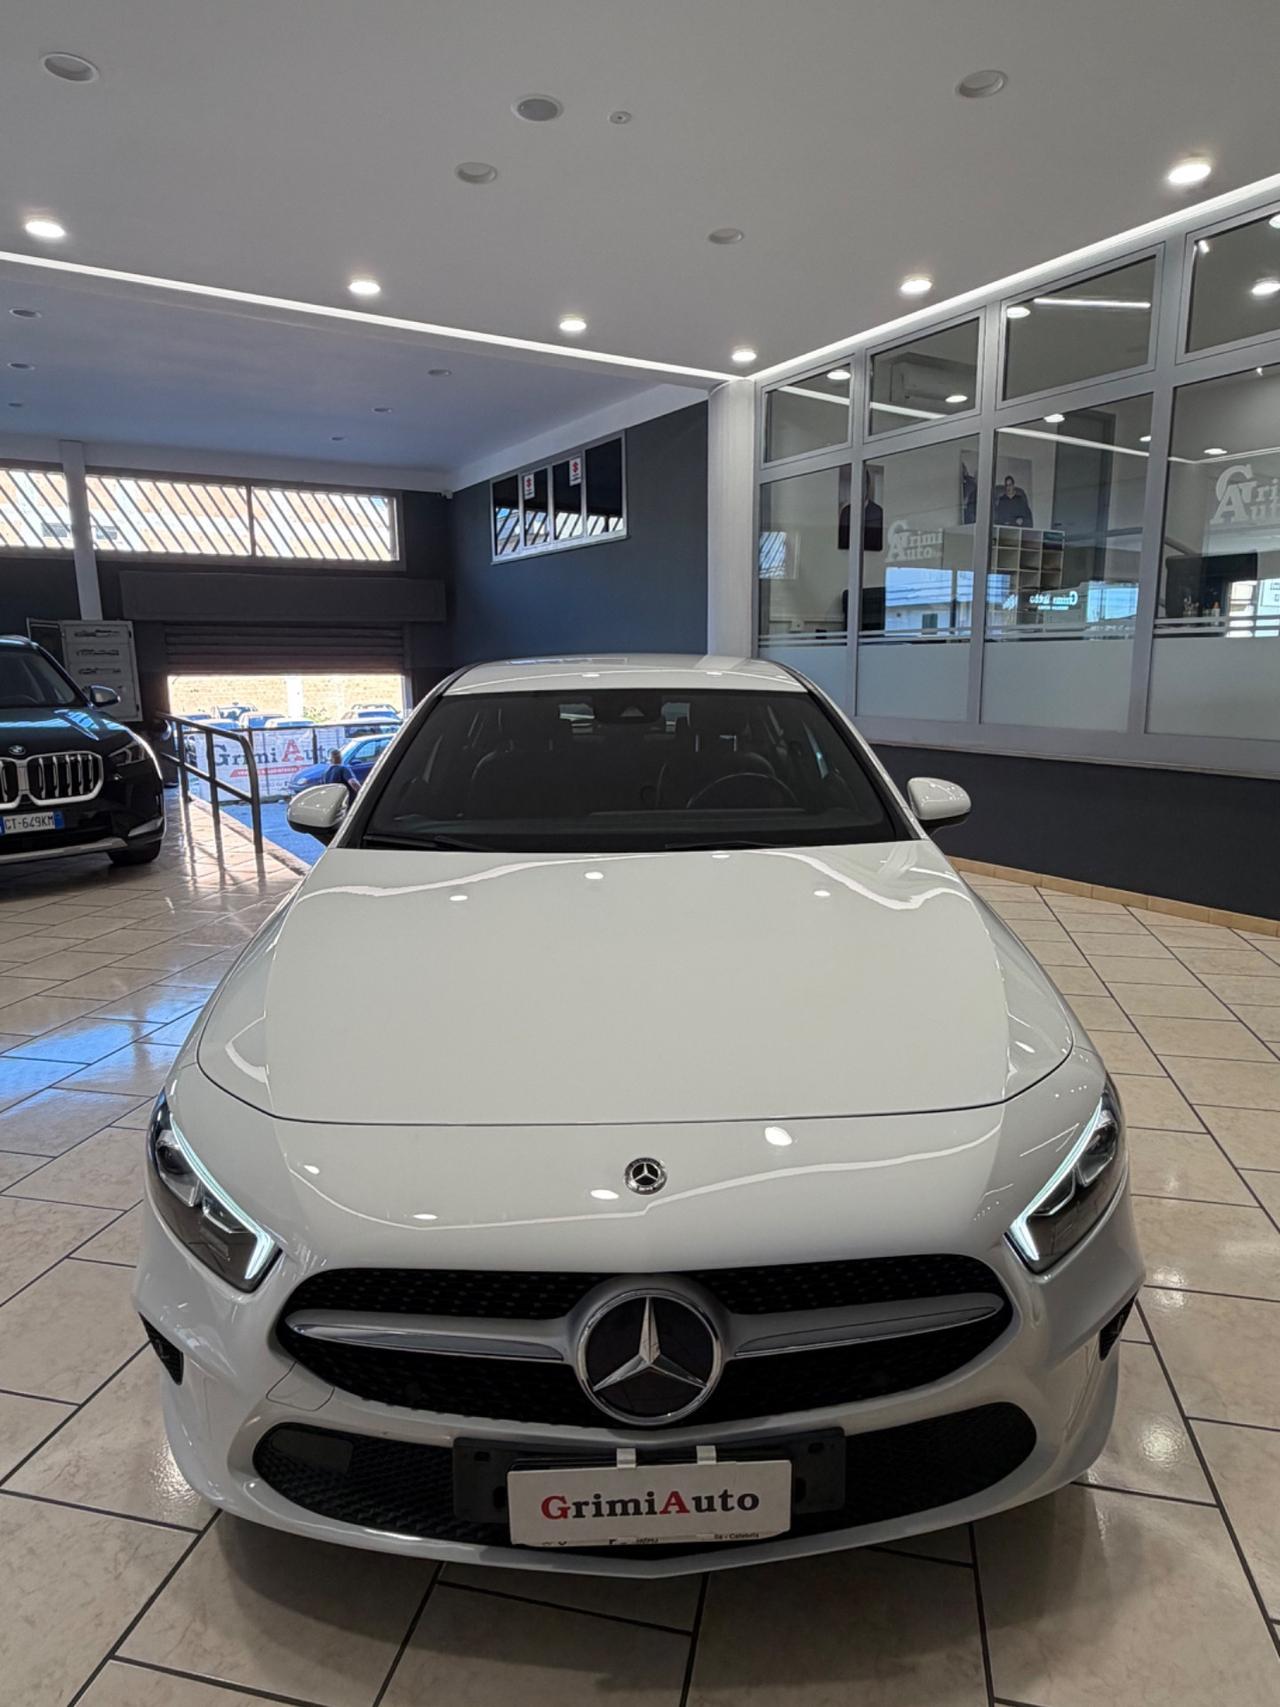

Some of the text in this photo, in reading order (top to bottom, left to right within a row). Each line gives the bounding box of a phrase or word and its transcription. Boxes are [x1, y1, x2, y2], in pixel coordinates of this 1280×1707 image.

[888, 520, 944, 547] Grimi
[885, 534, 932, 562] Auto
[541, 1490, 760, 1521] GrimiAuto
